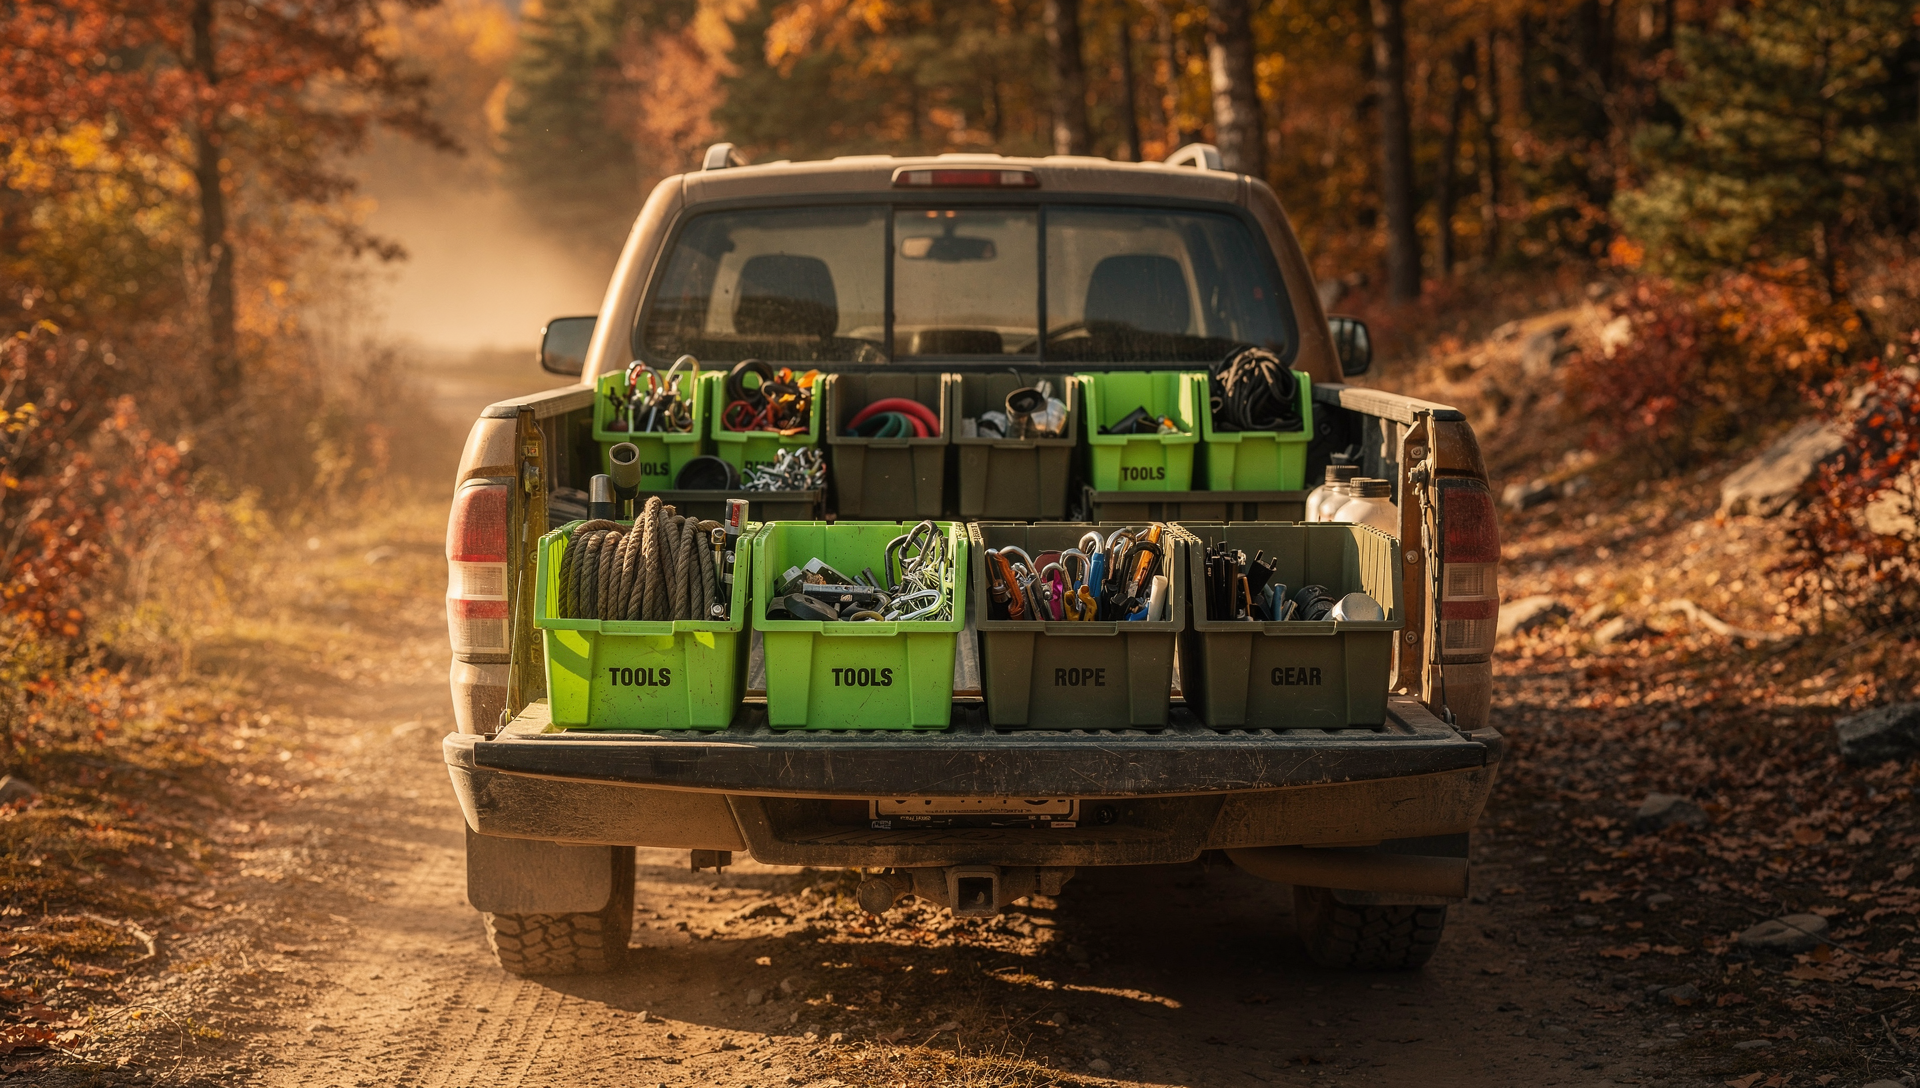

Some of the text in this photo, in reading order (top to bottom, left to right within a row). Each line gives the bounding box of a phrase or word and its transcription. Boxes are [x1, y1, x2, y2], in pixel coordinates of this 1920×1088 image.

[1121, 466, 1165, 481] TOOLS
[608, 667, 671, 687] TOOLS
[831, 667, 893, 687] TOOLS
[1054, 667, 1106, 687] ROPE
[1270, 667, 1322, 686] GEAR
